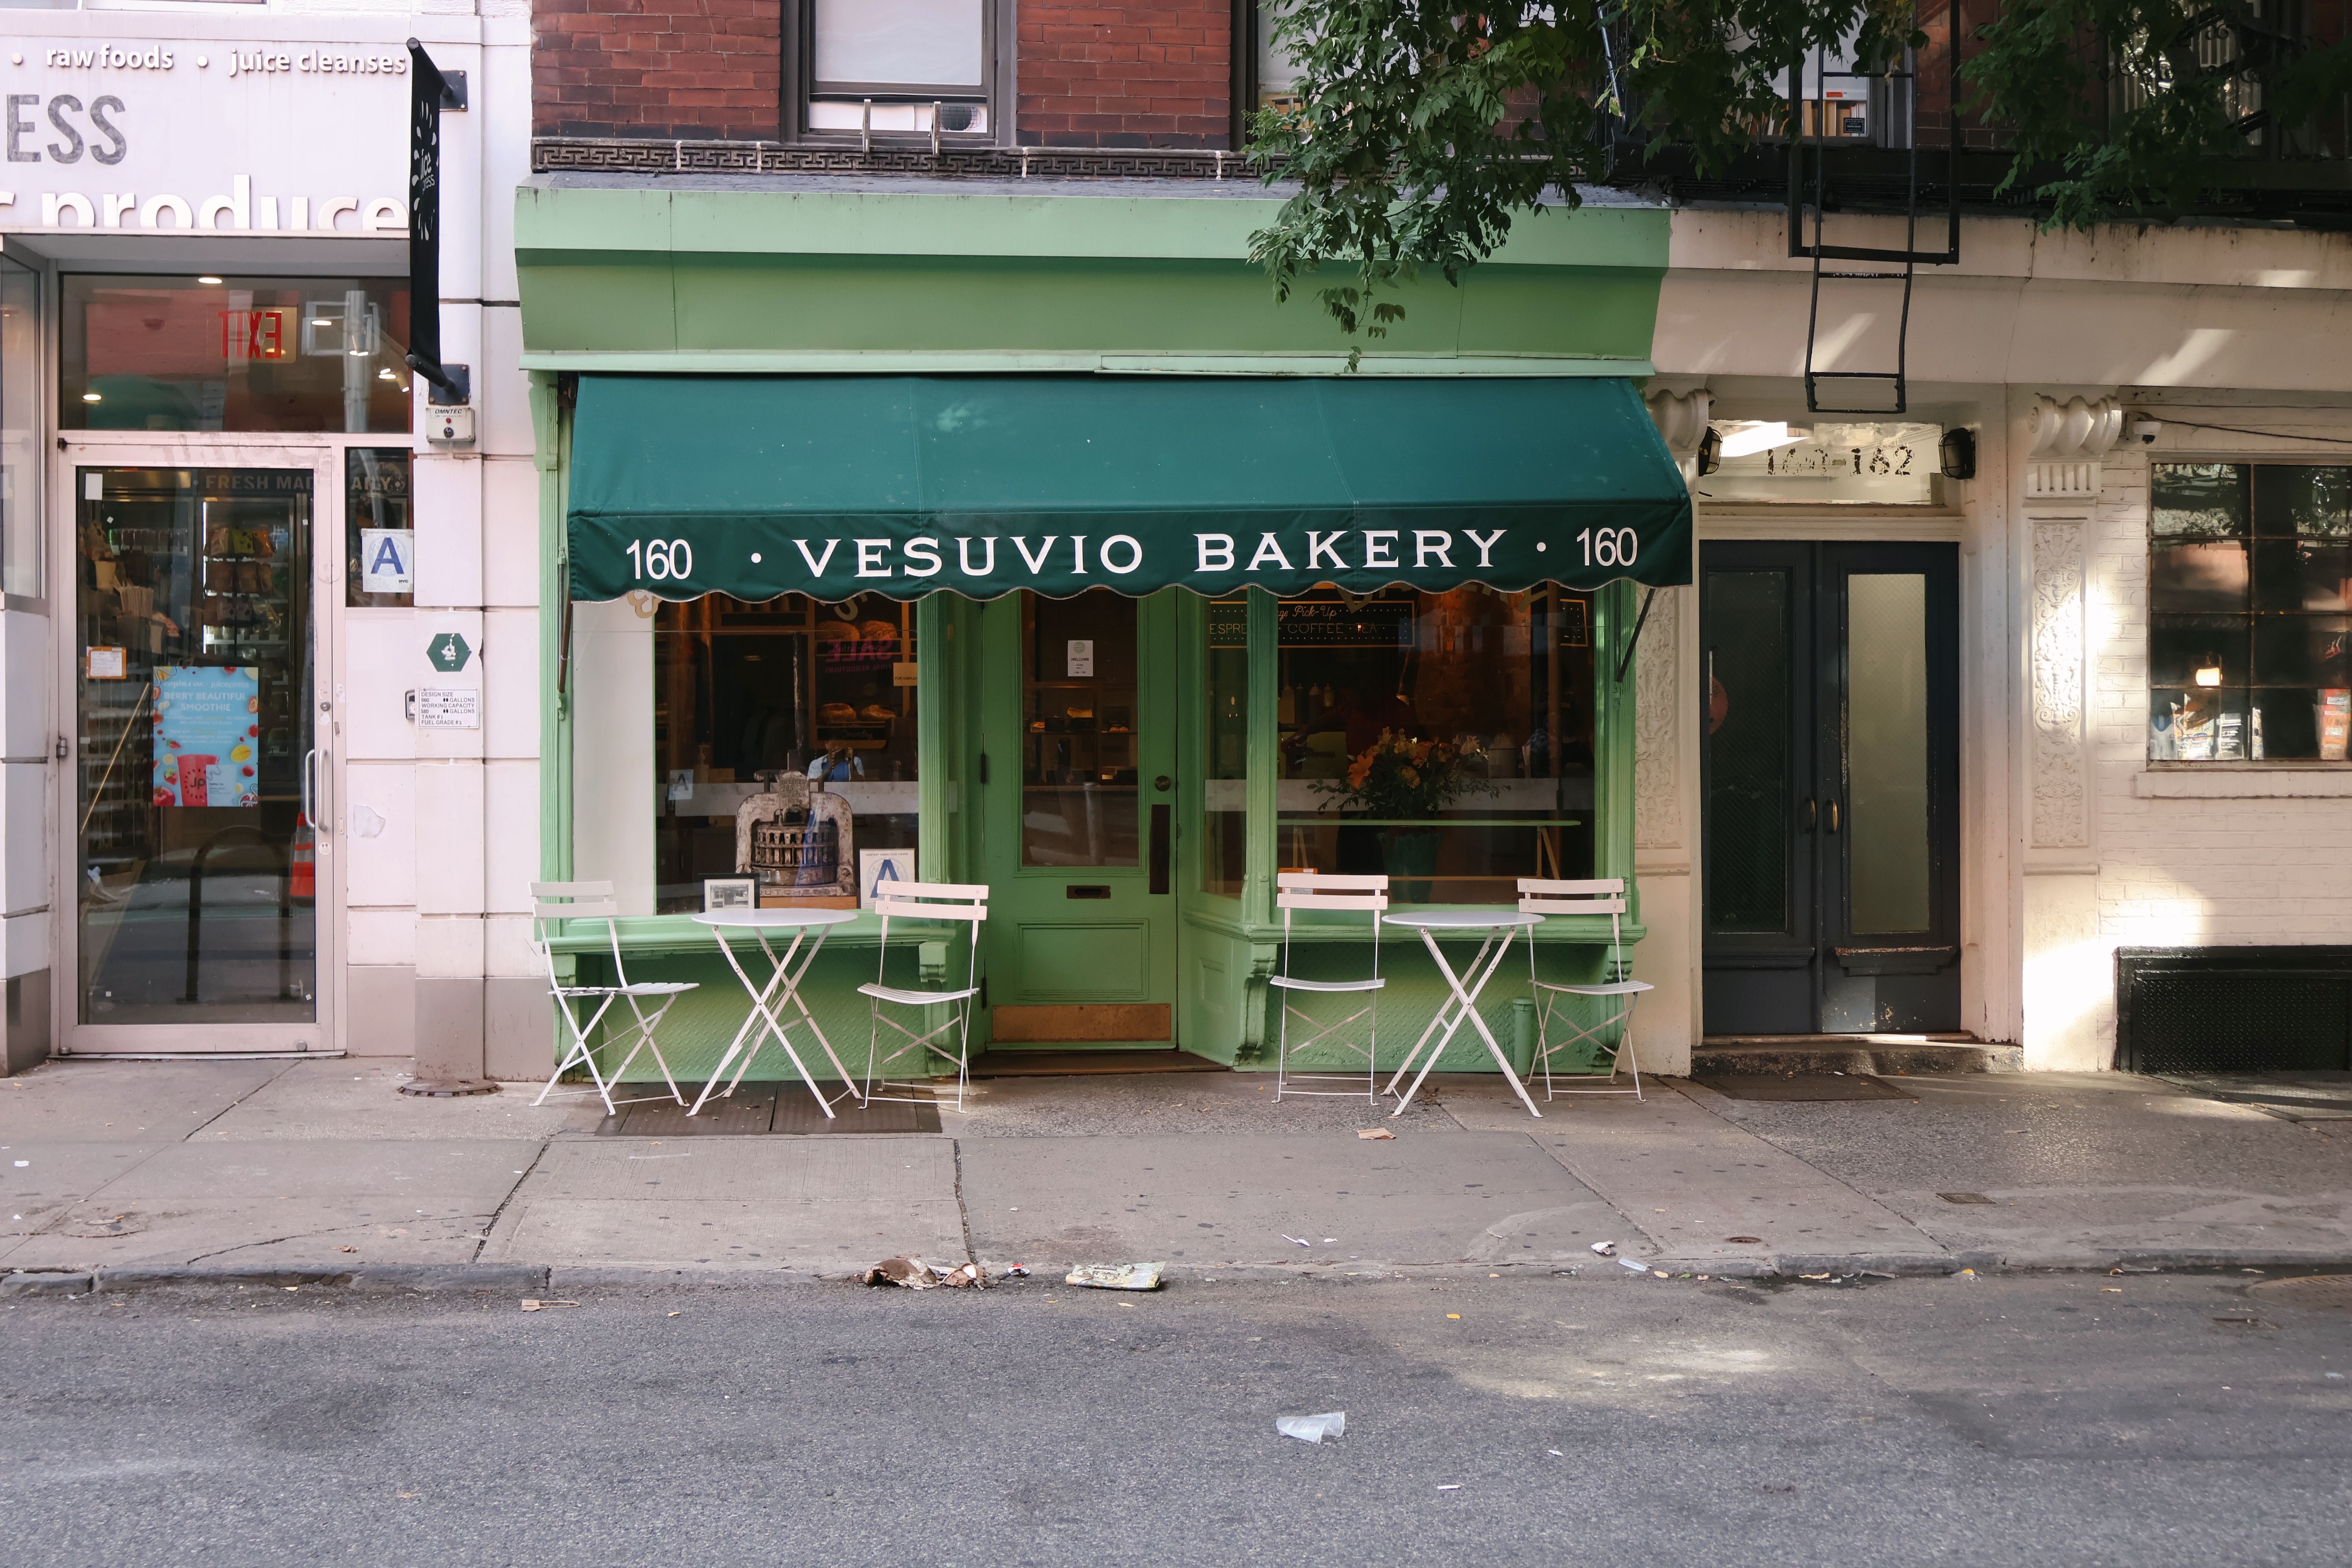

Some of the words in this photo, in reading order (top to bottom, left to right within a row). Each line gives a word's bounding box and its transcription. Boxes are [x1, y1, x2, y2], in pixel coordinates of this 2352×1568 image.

[47, 46, 94, 68] raw
[99, 43, 174, 69] foods
[229, 47, 290, 76] juice
[298, 49, 406, 74] cleanses
[7, 94, 127, 165] ESS
[206, 475, 268, 490] FRESH
[277, 475, 314, 490] MAD
[370, 537, 405, 574] A
[626, 539, 692, 580] 160
[792, 534, 1142, 578] VESUVIO
[1193, 529, 1507, 572] BAKERY
[1576, 527, 1638, 566] 160
[1292, 605, 1337, 620] Pick-Up
[1210, 624, 1247, 634] ESPRE
[1287, 623, 1344, 634] COFFEE
[1356, 623, 1377, 633] TEA
[196, 692, 246, 701] BEAUTIFUL
[870, 859, 906, 898] A
